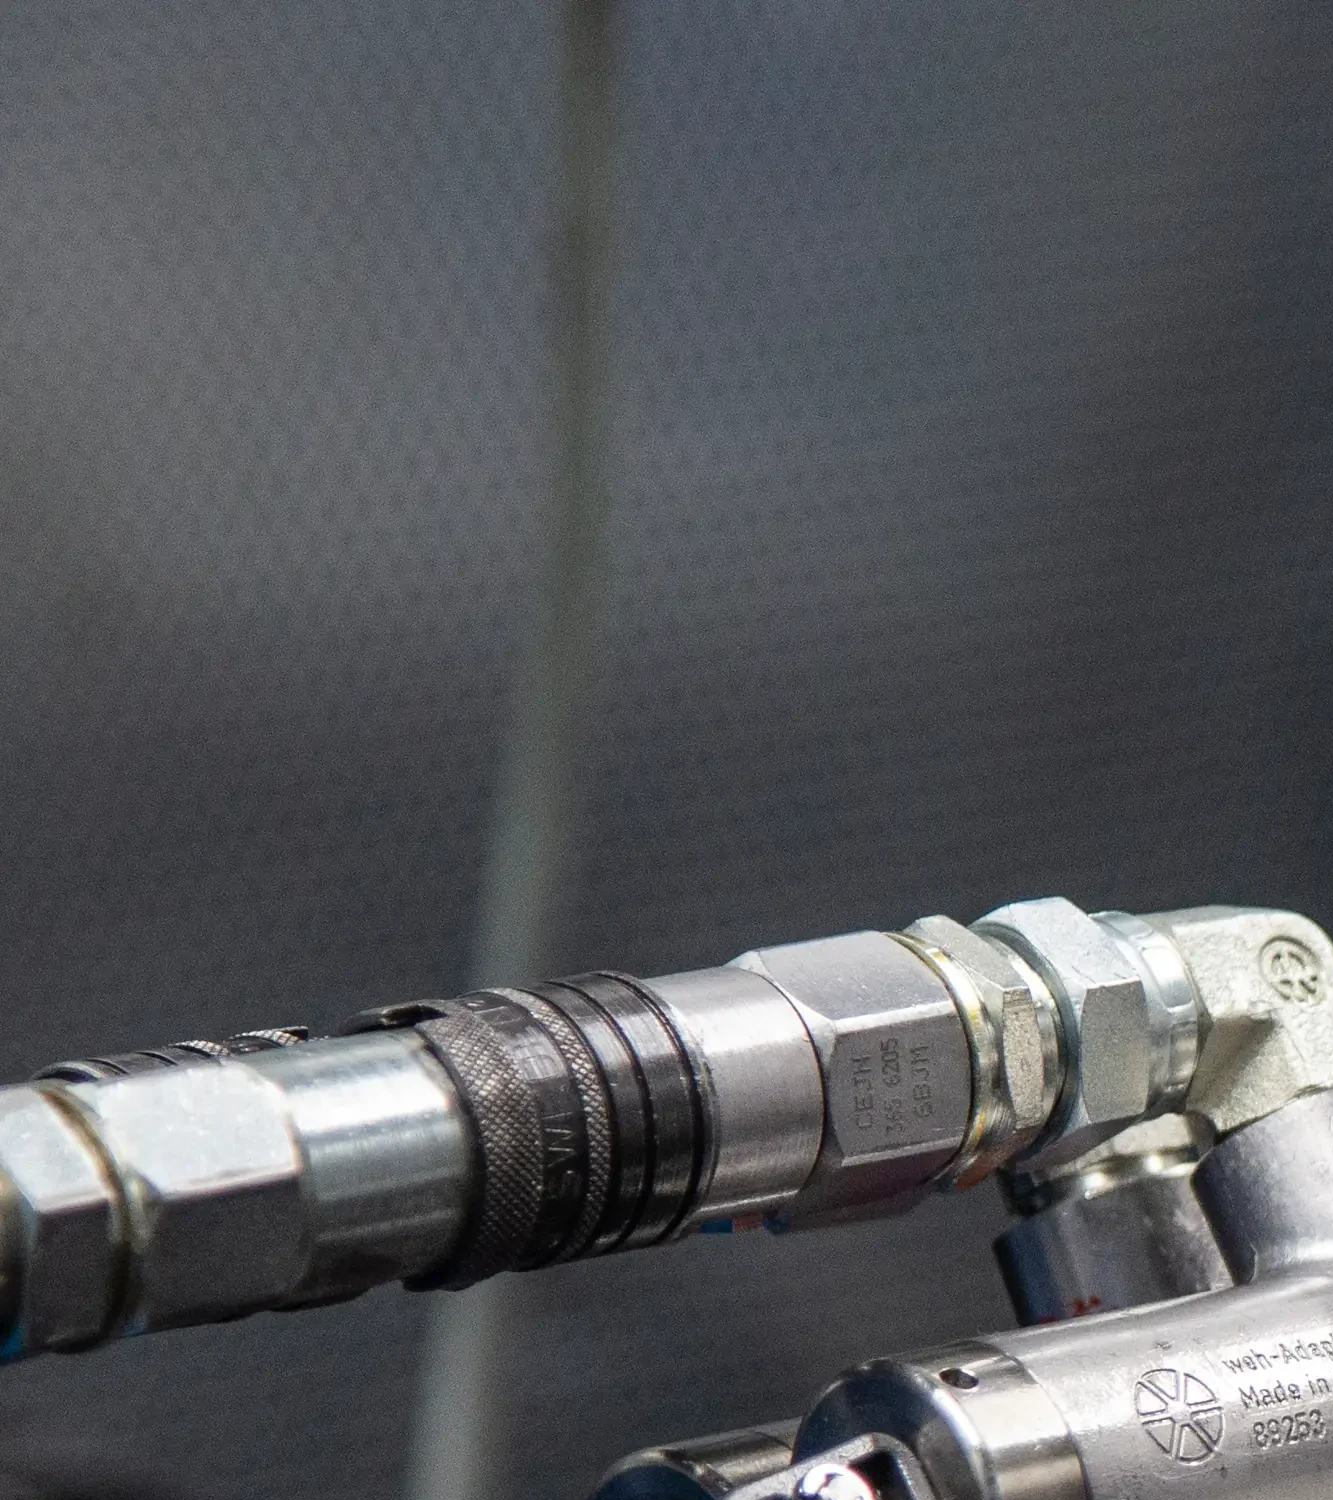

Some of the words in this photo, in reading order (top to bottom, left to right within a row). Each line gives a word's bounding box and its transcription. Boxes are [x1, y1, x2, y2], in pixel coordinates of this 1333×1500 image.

[1238, 1380, 1302, 1410] Made
[1305, 1373, 1331, 1397] in
[1252, 1408, 1328, 1450] 89253
